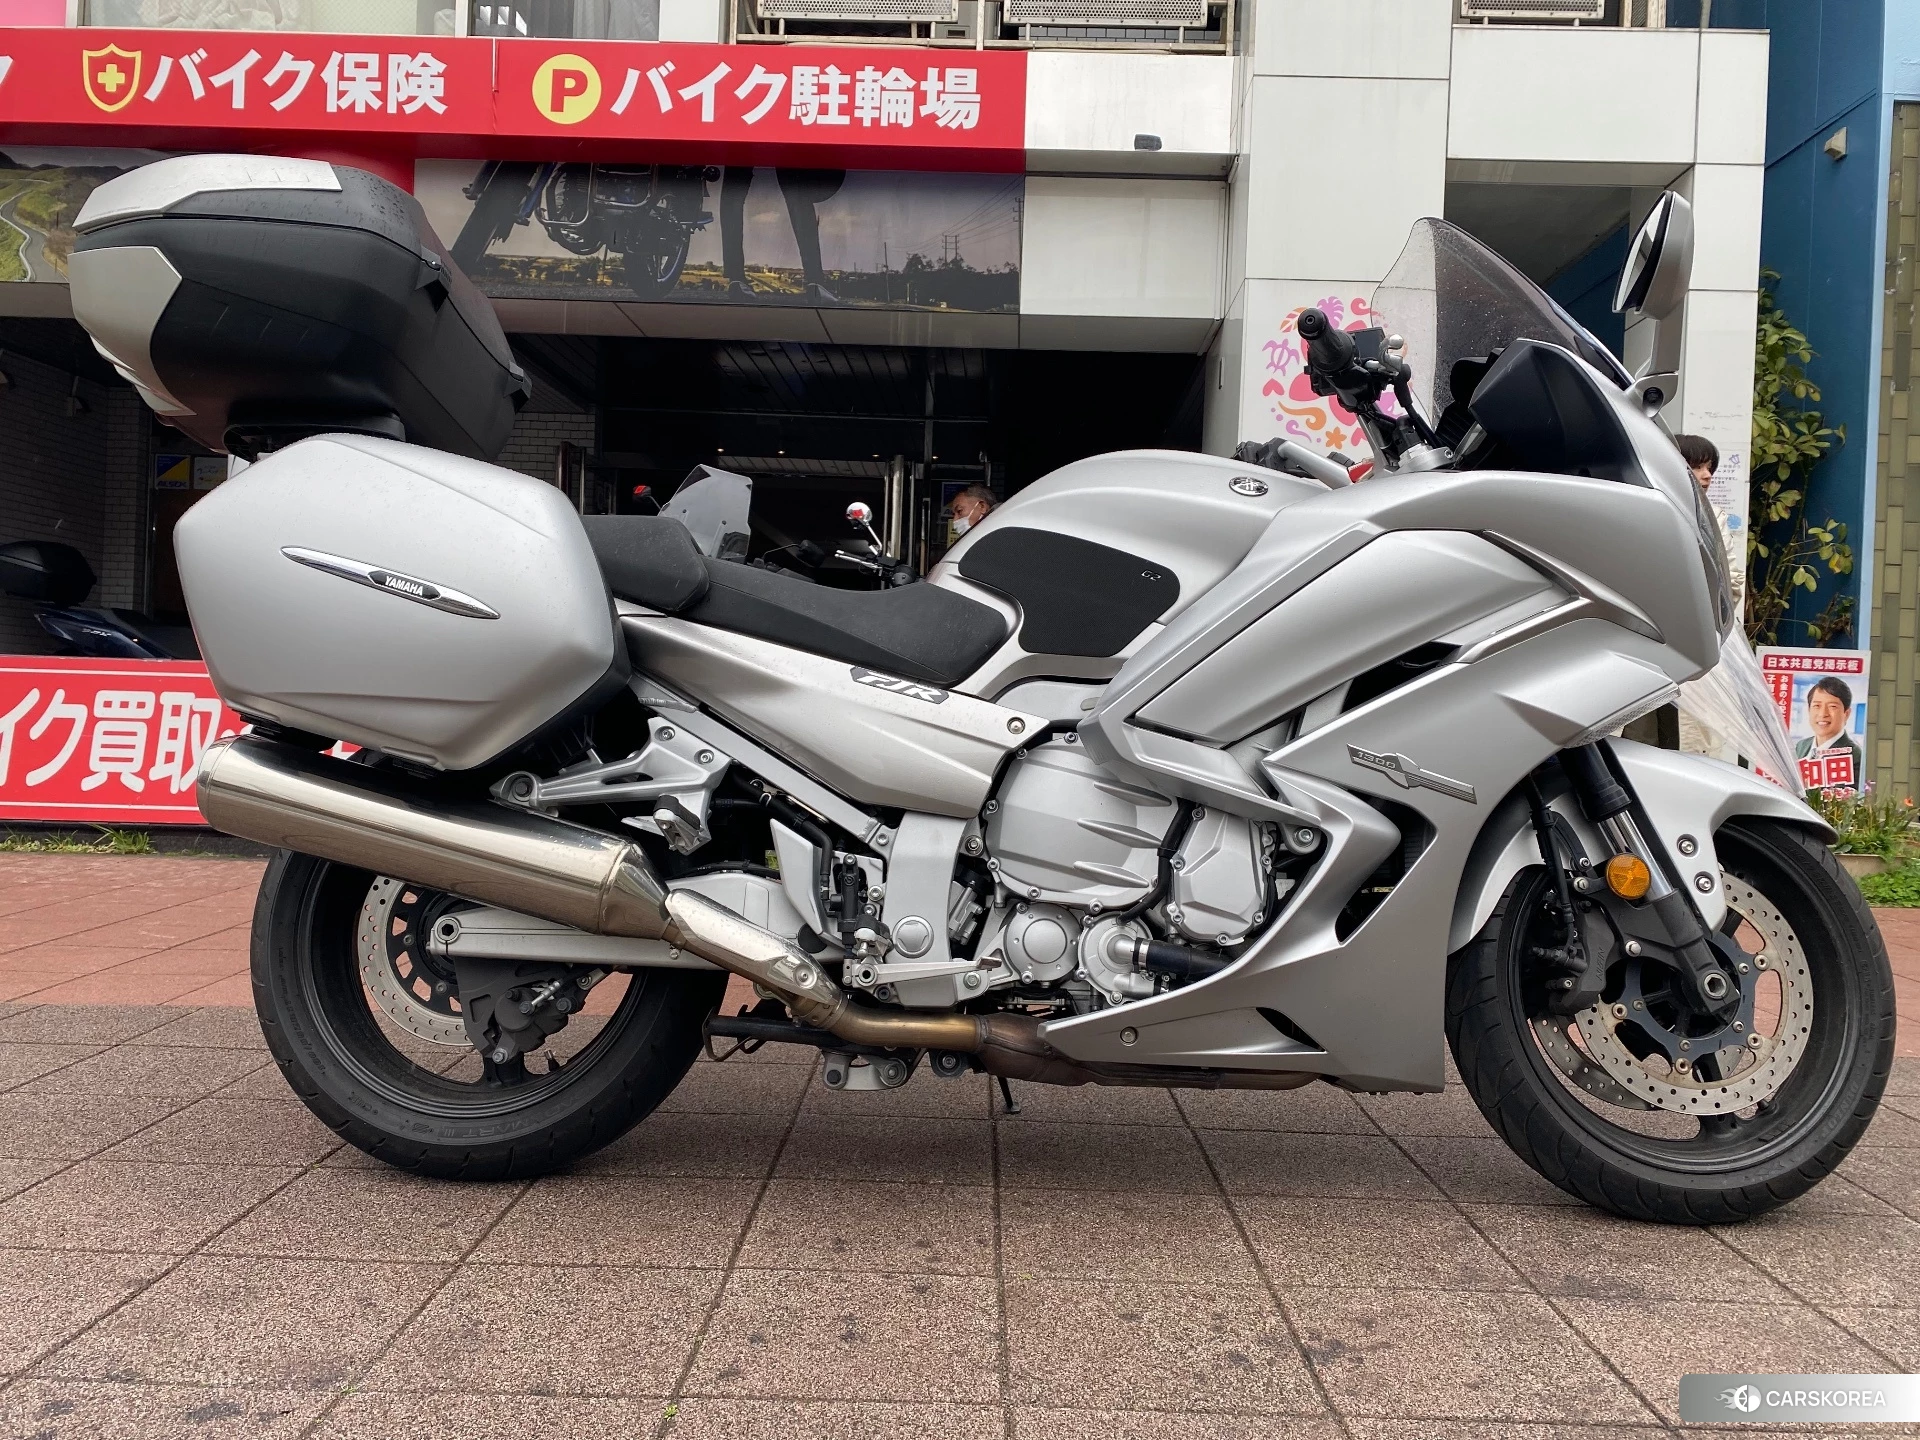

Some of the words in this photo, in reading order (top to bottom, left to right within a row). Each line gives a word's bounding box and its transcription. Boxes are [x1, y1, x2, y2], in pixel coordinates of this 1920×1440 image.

[143, 48, 448, 115] バイク保険
[550, 68, 588, 113] P
[610, 59, 981, 129] バイク駐輪場
[384, 575, 424, 596] YAMAHA
[1767, 657, 1859, 671] 日本共産党掲示板
[856, 670, 943, 702] FJR
[1357, 751, 1396, 769] 1300
[1798, 757, 1853, 788] 和田
